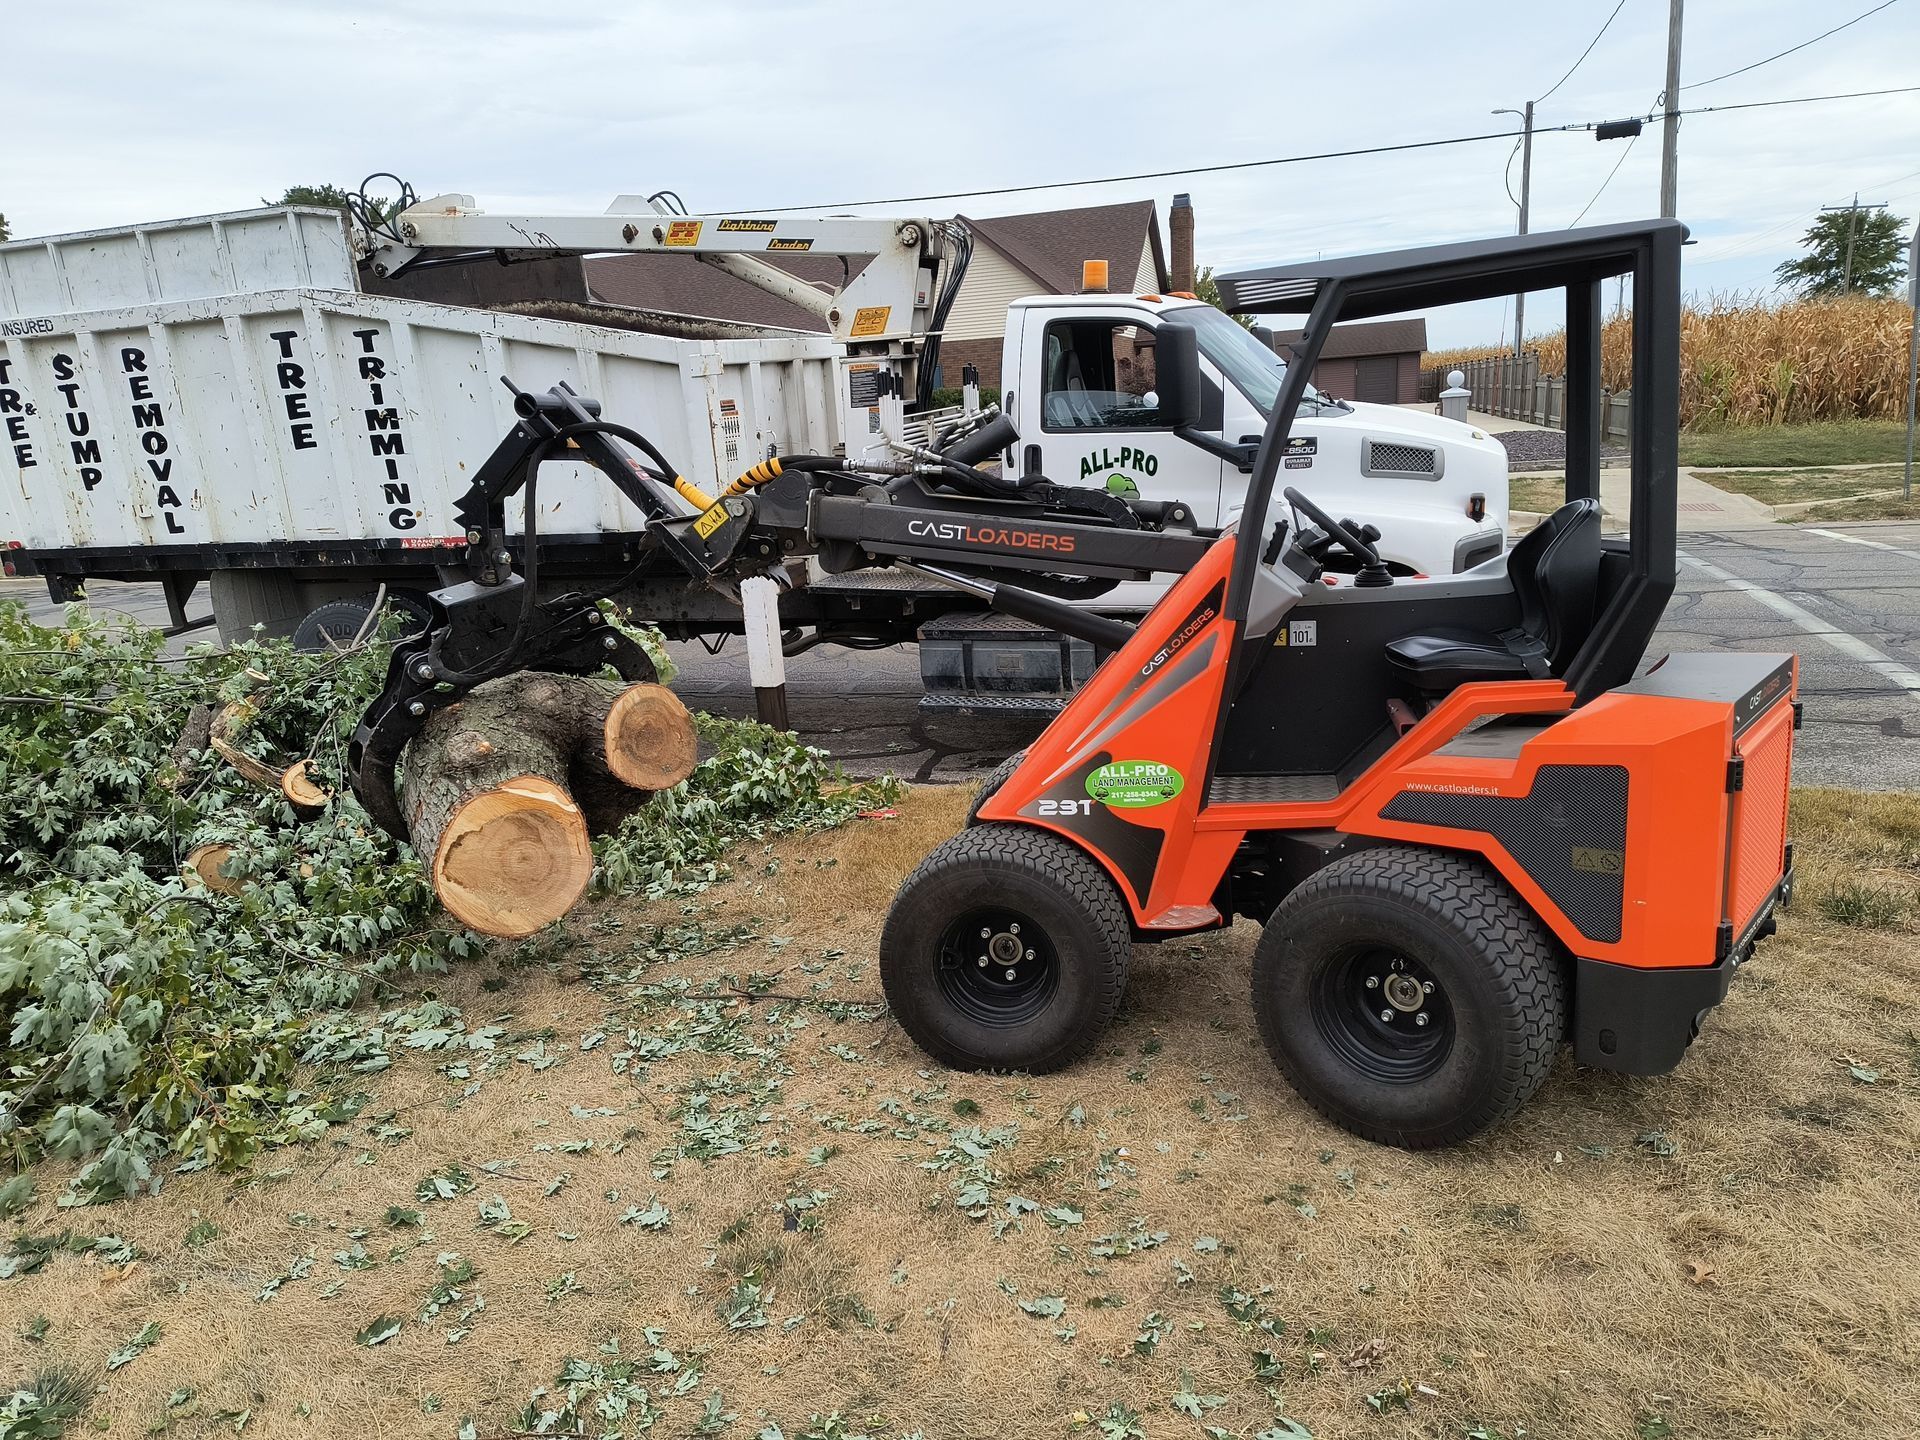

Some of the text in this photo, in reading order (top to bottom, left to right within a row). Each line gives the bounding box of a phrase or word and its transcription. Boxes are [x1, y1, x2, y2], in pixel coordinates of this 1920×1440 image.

[719, 219, 775, 232] Lightning
[1, 319, 54, 336] INSURED
[269, 329, 417, 530] TREE TRIMMING
[0, 347, 185, 534] TREE & STUMP REMOVAL
[1080, 446, 1158, 481] ALL-PRO
[908, 520, 1075, 552] CASTLOADERS
[1142, 607, 1215, 676] CASTLOADERS
[1292, 630, 1309, 643] 101
[1098, 764, 1169, 778] ALL-PRO
[1093, 776, 1175, 788] LAND MANAGEMENT
[1406, 782, 1499, 796] www.castloaders.it
